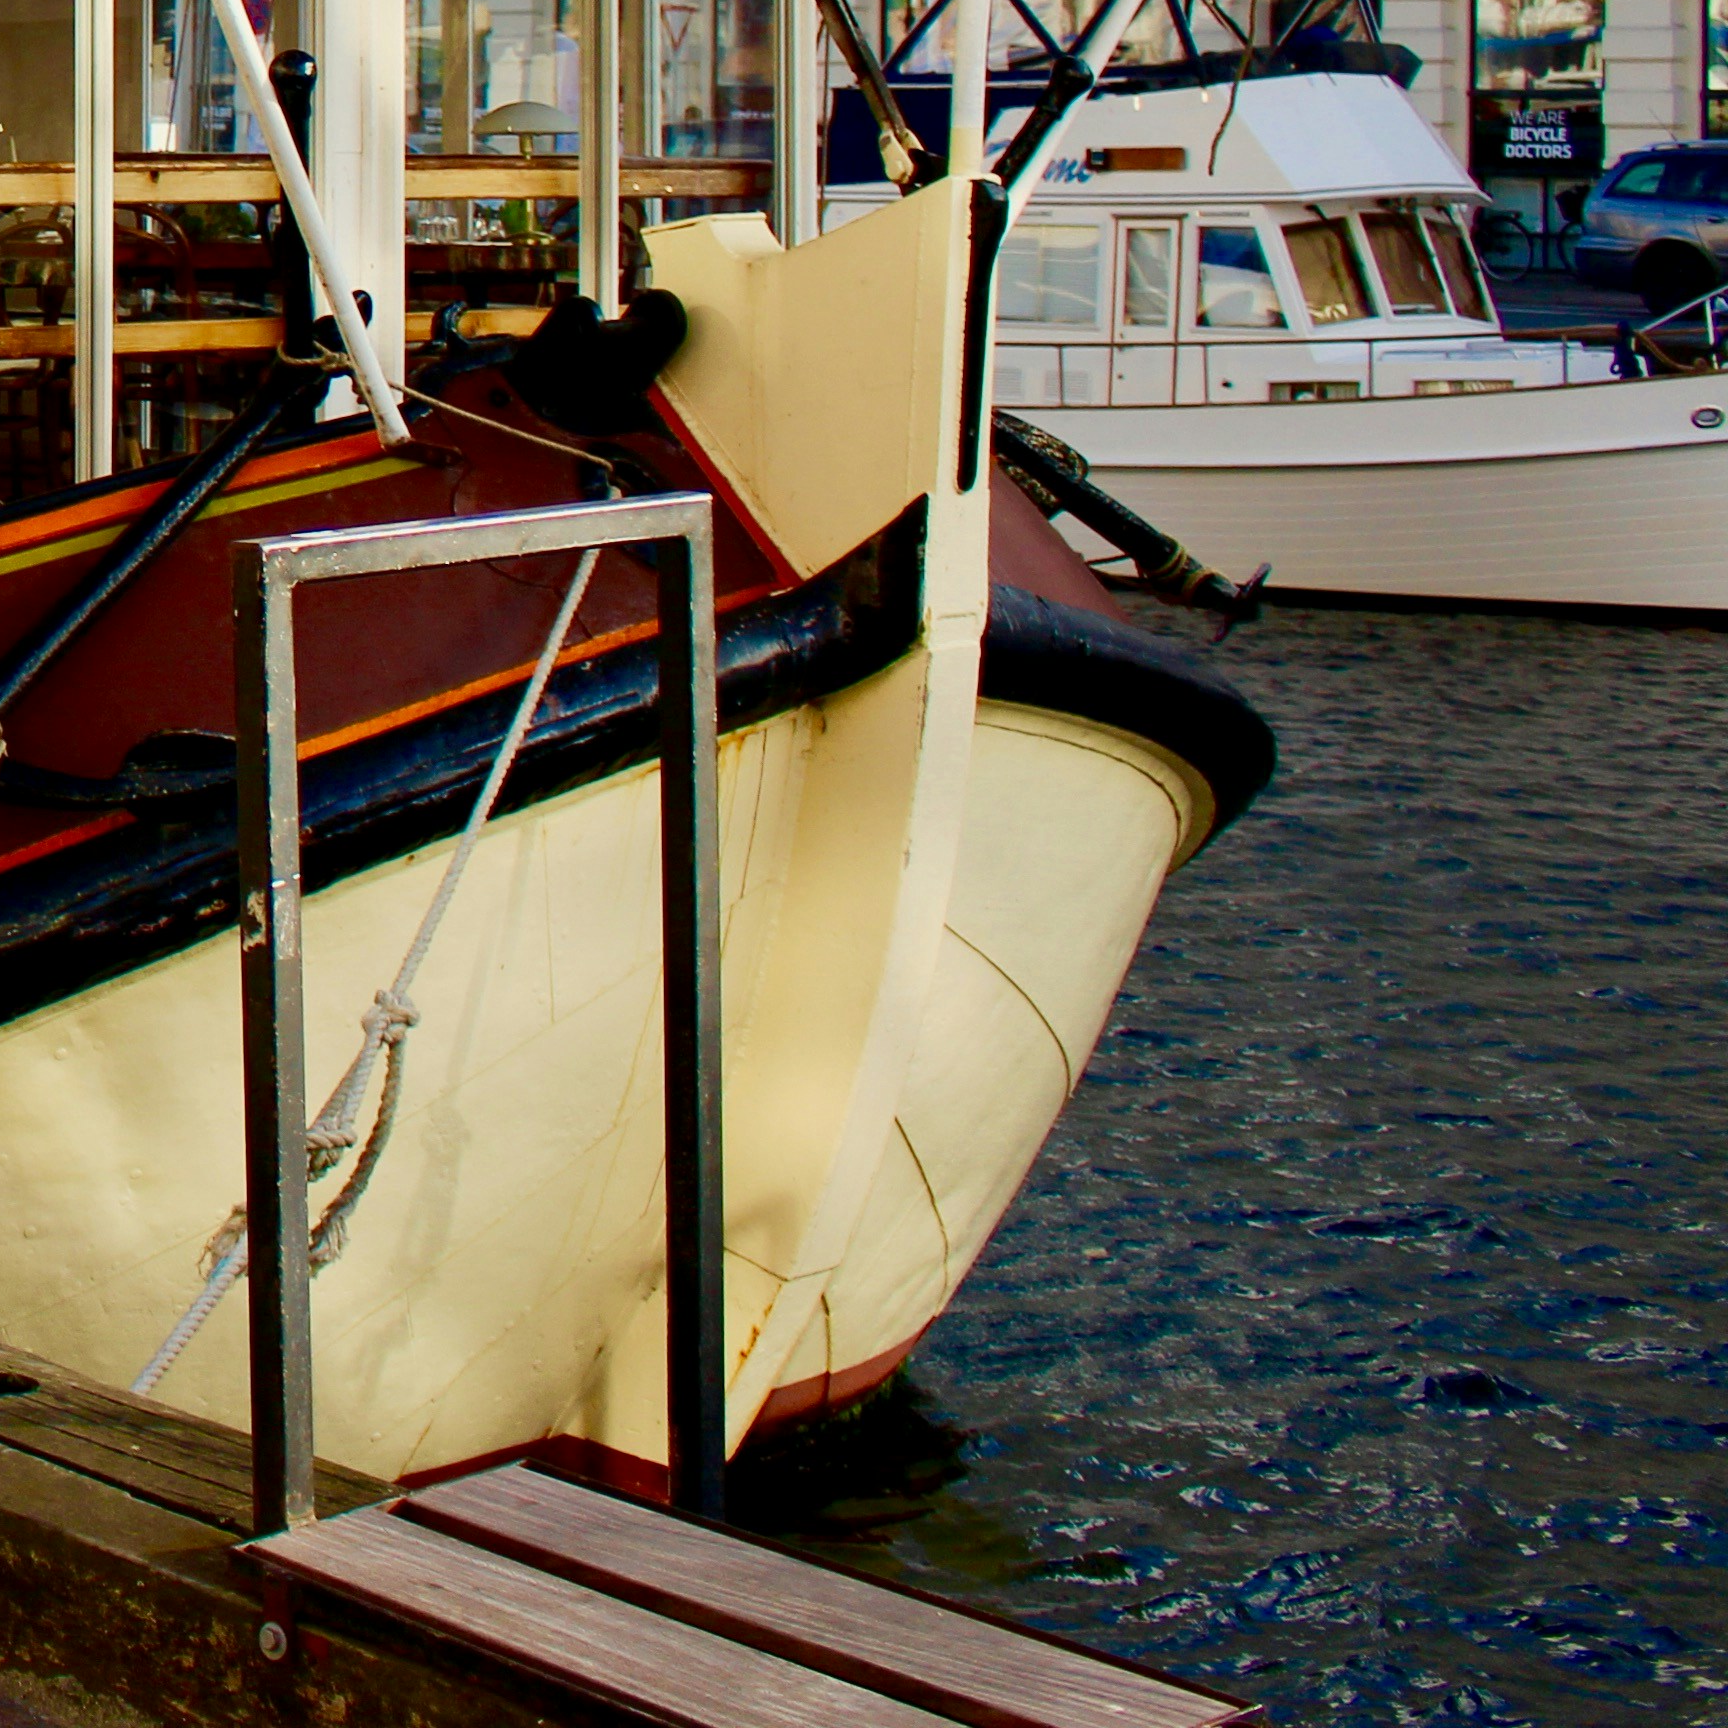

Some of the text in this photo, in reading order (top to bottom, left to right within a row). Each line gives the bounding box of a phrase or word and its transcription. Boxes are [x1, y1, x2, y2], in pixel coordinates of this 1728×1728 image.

[1510, 110, 1566, 125] WE ARE
[1510, 127, 1567, 142] BICYCLE
[1505, 144, 1572, 159] DOCTORS
